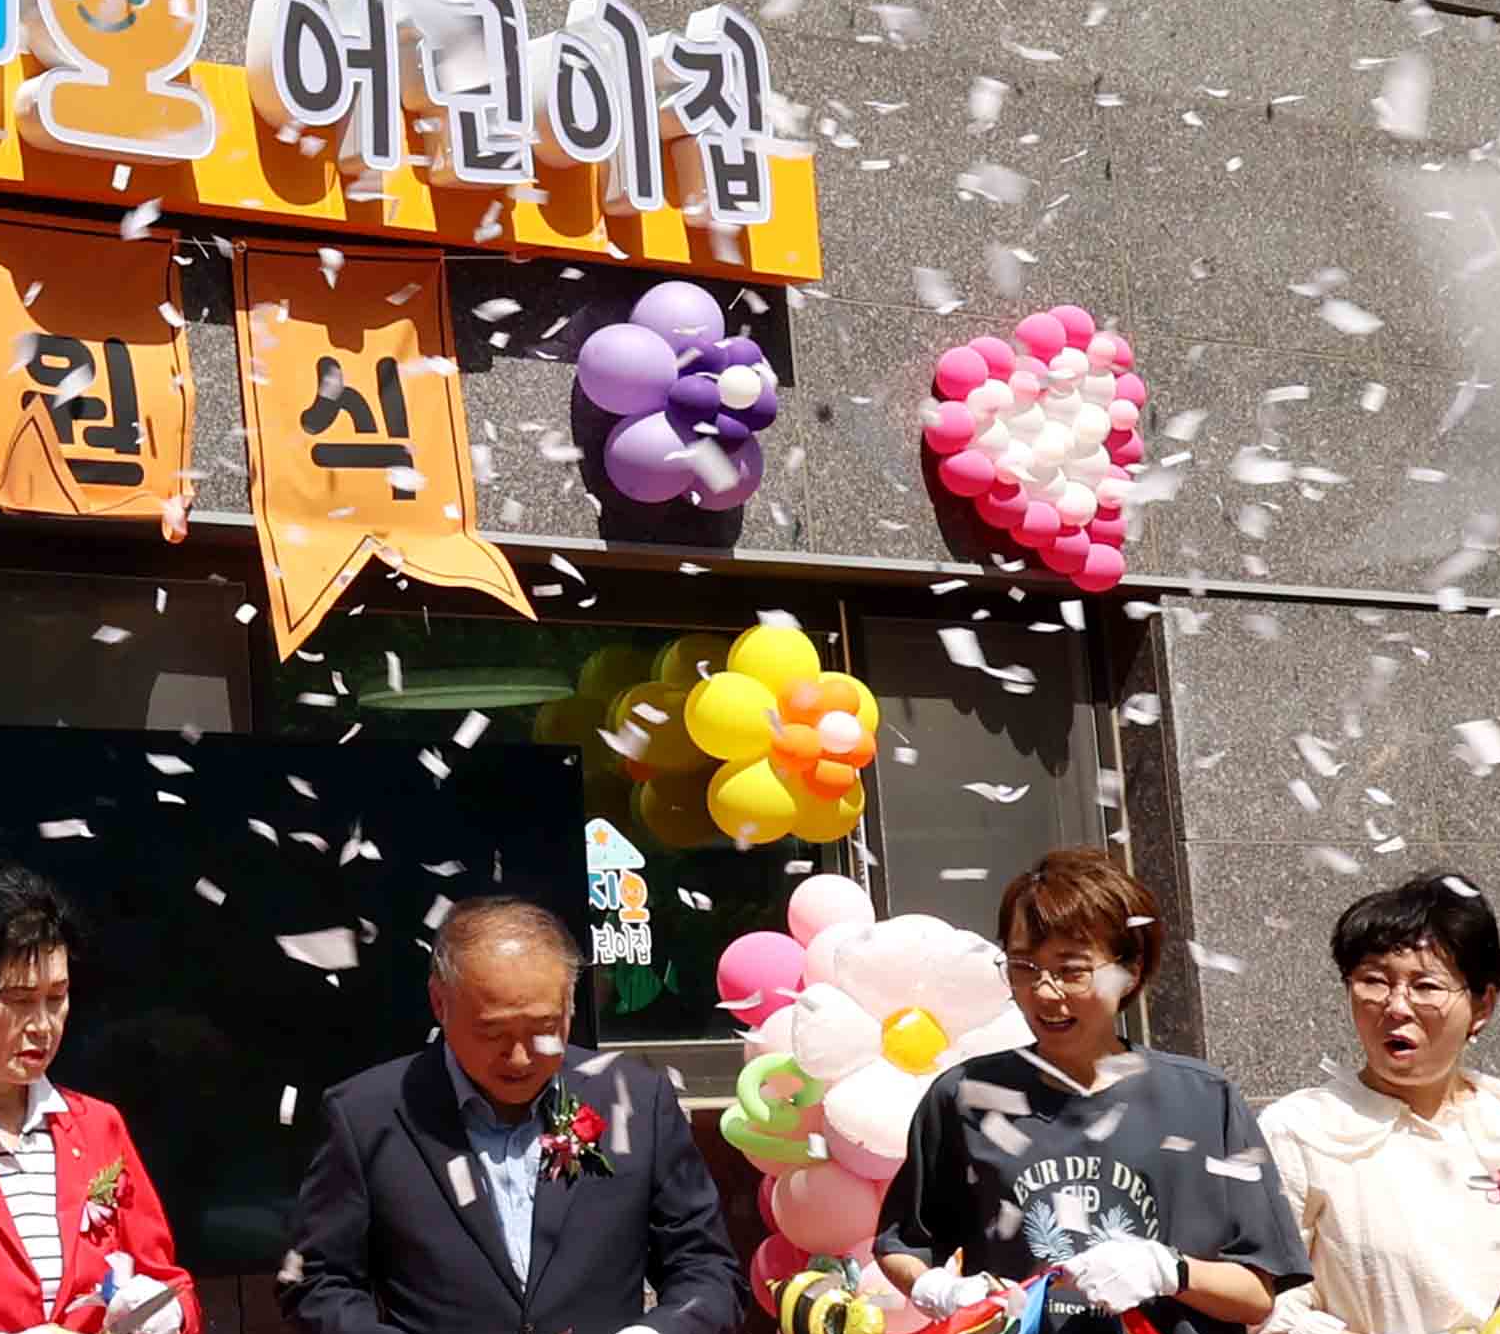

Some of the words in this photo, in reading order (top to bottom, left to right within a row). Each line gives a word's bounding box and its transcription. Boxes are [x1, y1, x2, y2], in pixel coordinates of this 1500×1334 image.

[592, 923, 652, 965] 린이집
[1064, 1155, 1101, 1181] DE
[1047, 1298, 1086, 1316] ince
